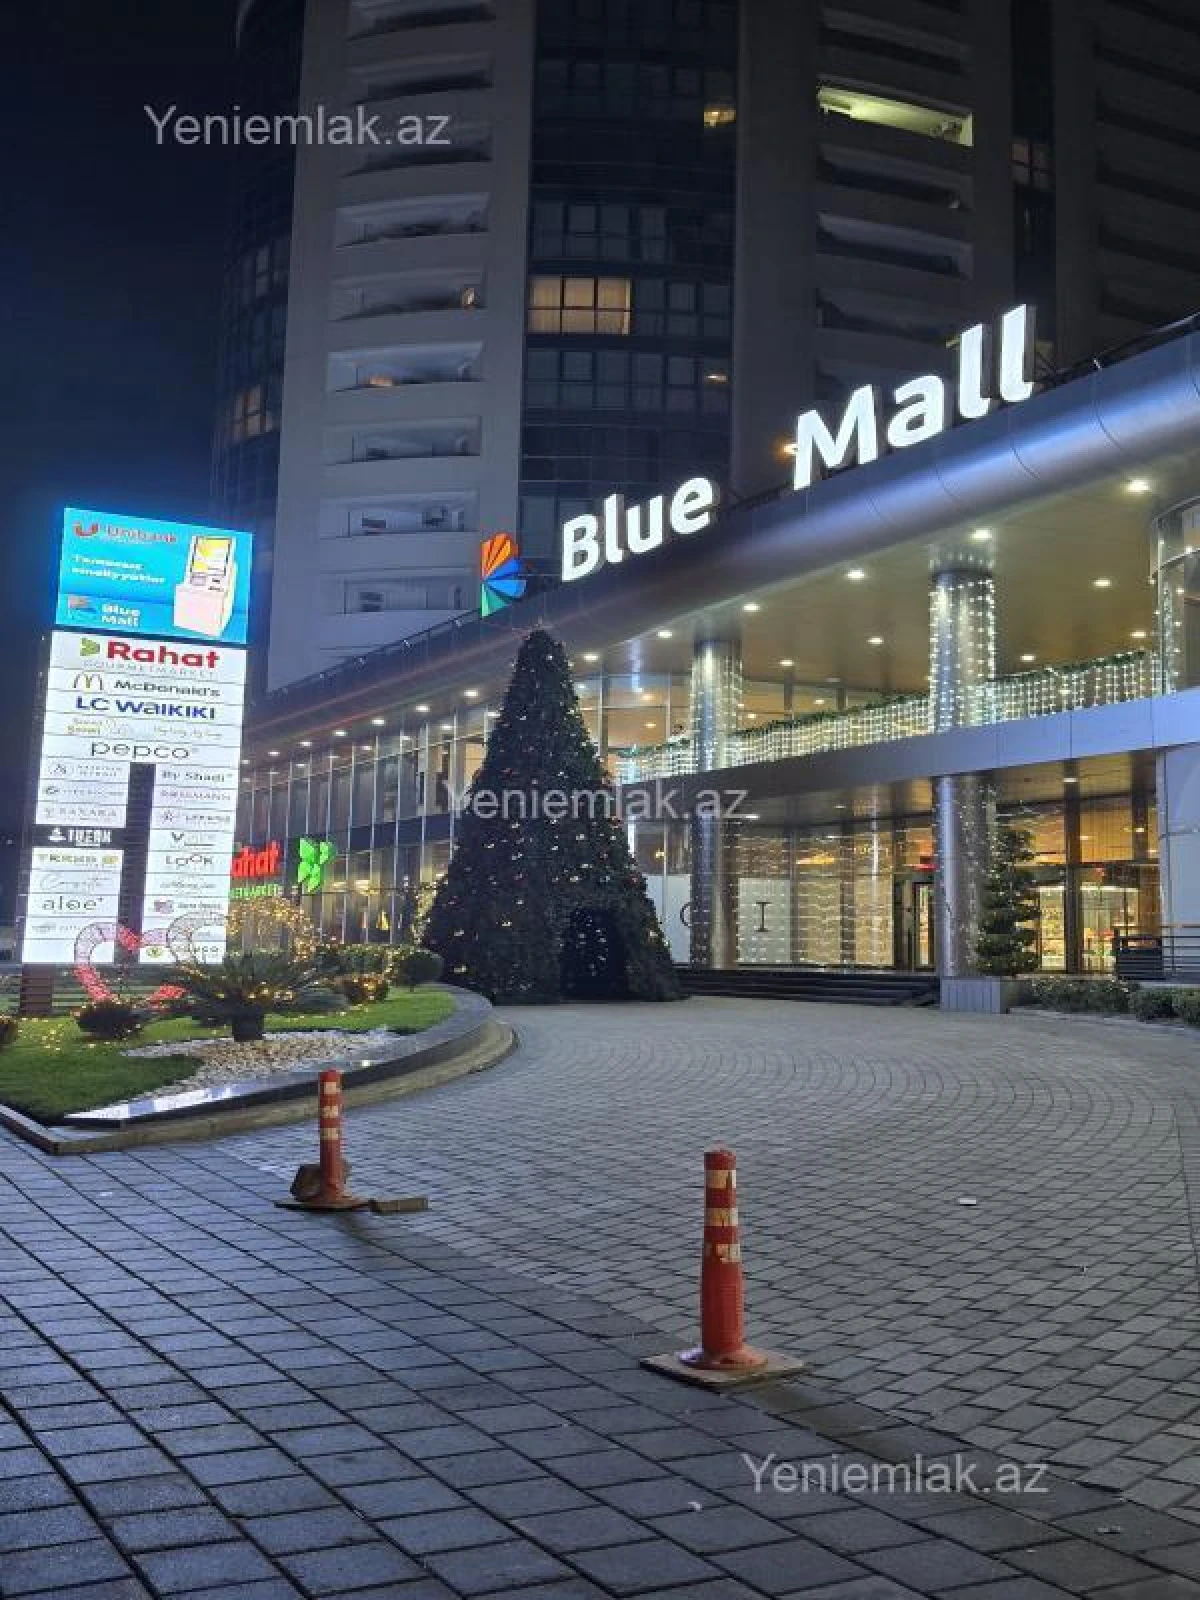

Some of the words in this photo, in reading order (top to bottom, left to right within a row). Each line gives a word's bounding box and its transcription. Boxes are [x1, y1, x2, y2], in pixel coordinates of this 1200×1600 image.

[561, 476, 718, 583] Blue
[793, 303, 1036, 491] Mall
[101, 603, 141, 617] Blue
[101, 615, 139, 628] Mall
[107, 640, 220, 669] Rahat
[113, 679, 221, 697] McDonald's
[76, 696, 110, 711] LC
[91, 741, 189, 760] pepco
